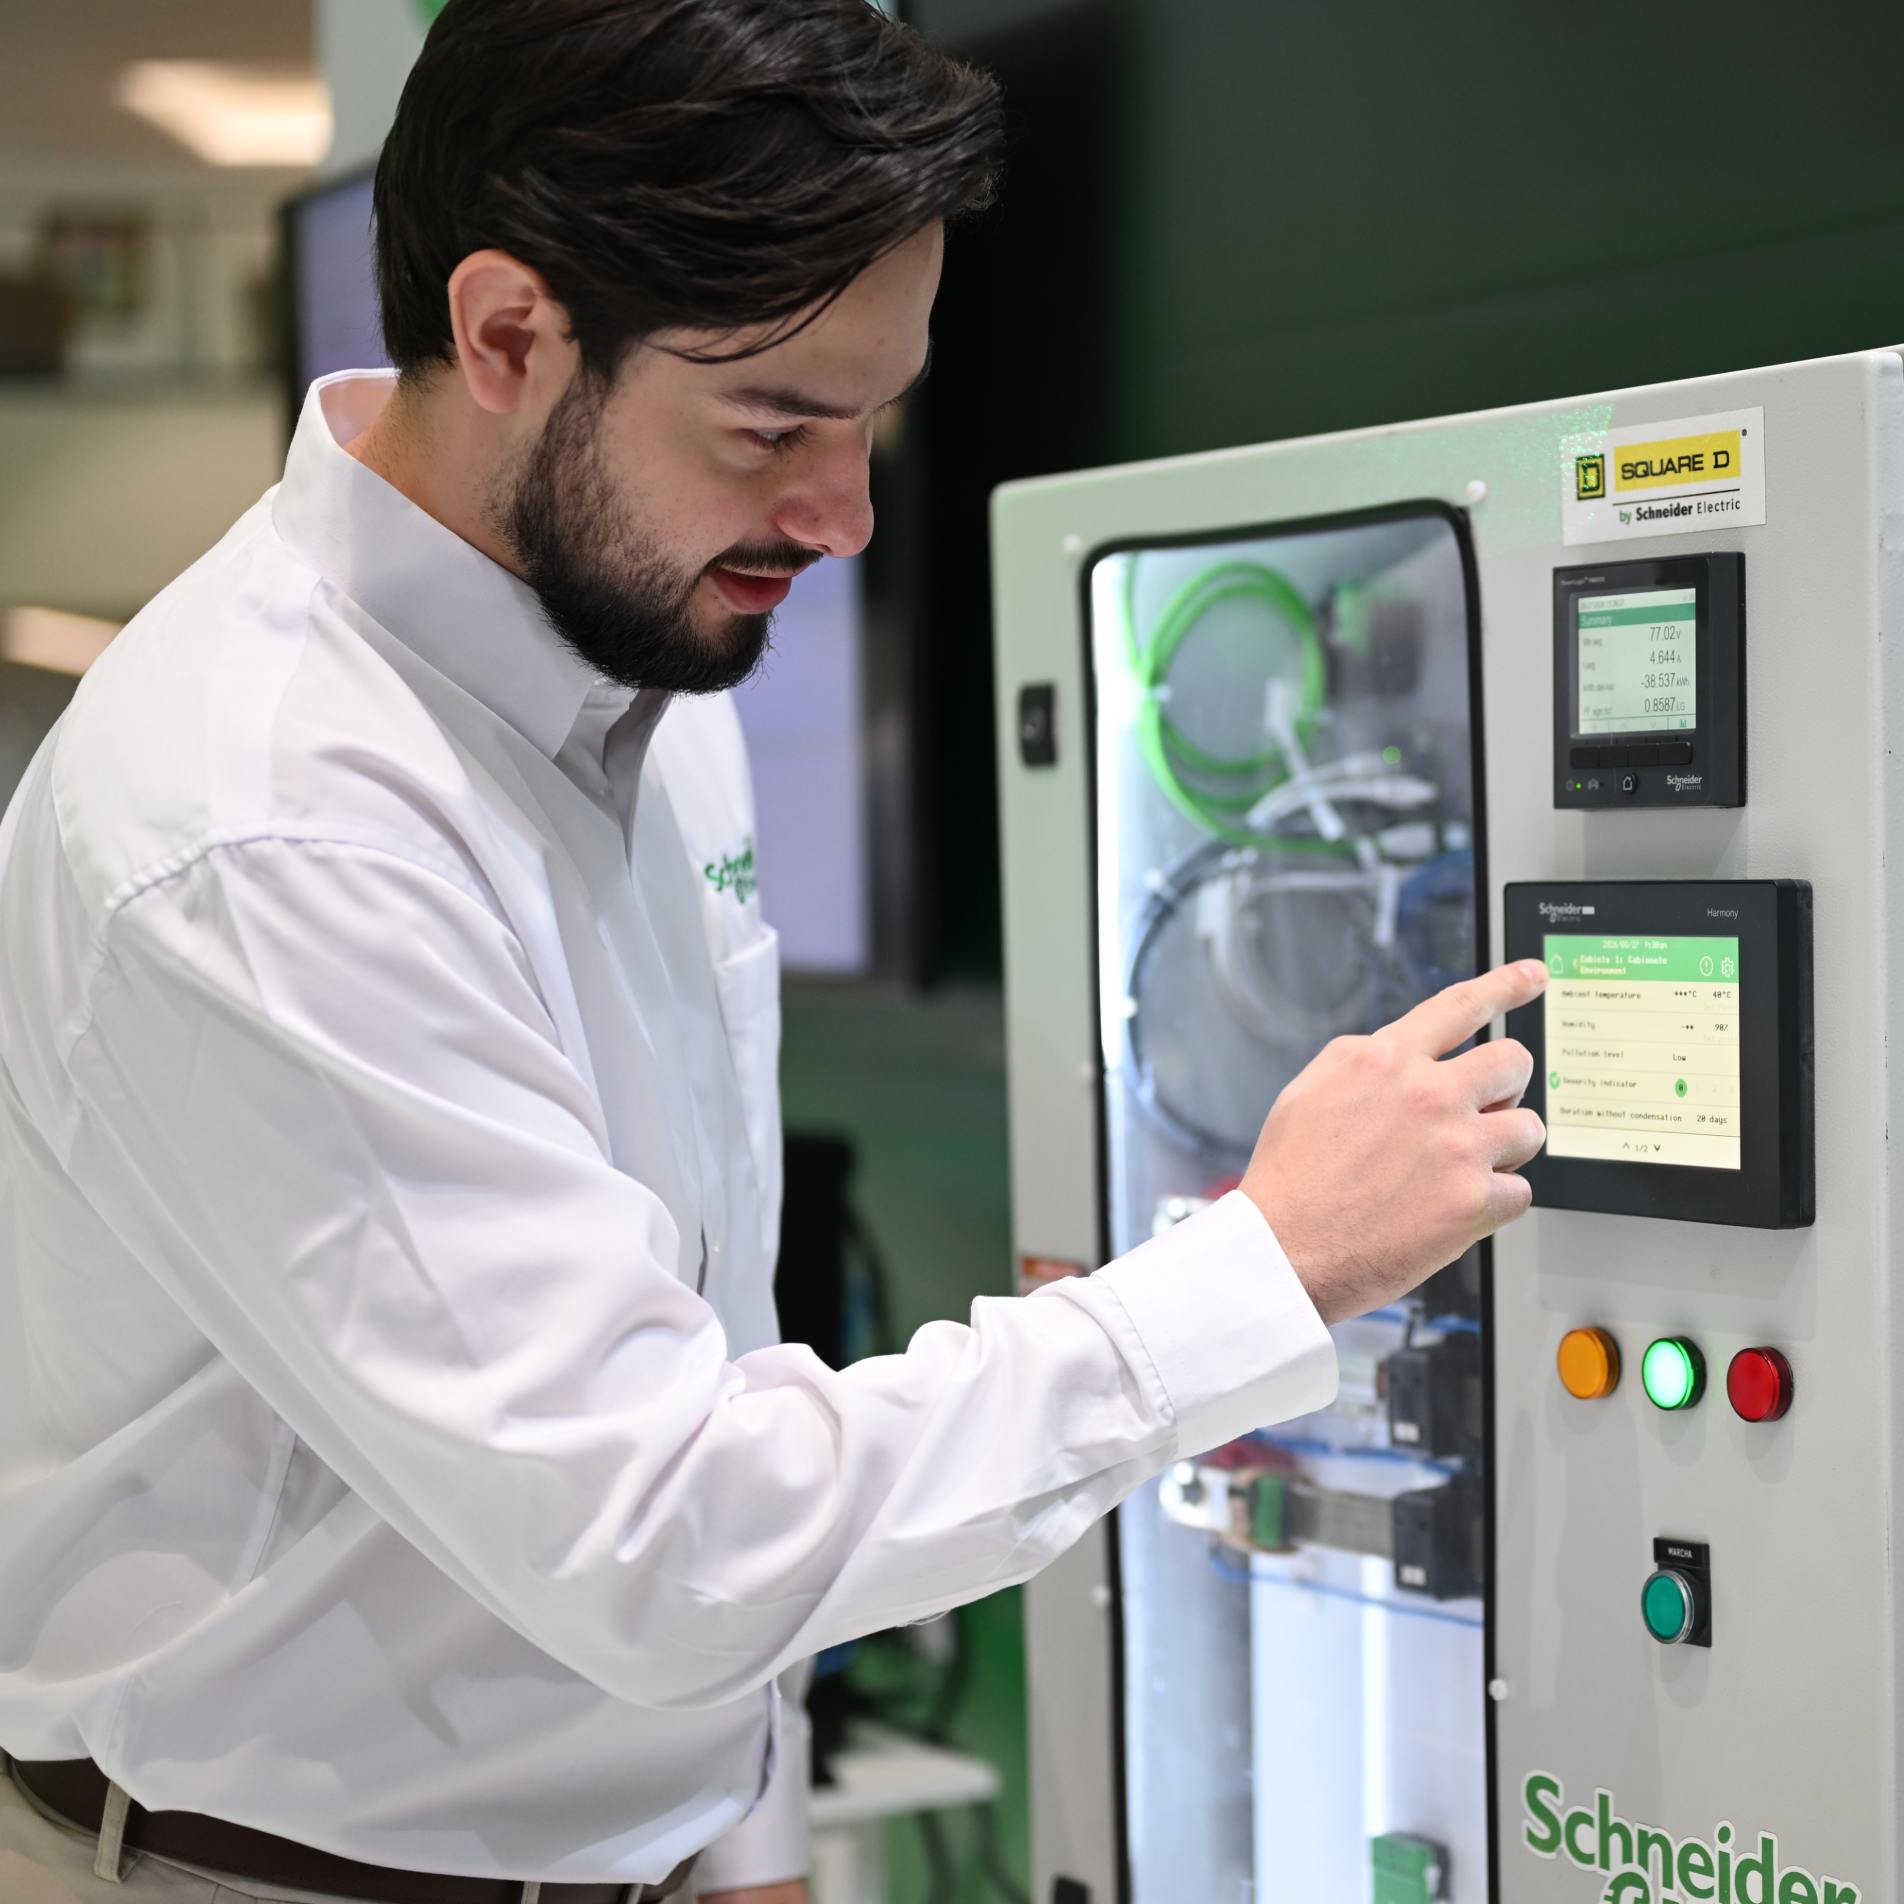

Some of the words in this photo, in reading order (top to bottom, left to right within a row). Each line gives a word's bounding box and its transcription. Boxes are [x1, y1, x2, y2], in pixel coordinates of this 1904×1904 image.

[1621, 453, 1704, 480] SQUARE
[1713, 450, 1730, 469] D
[1619, 511, 1633, 525] by
[1636, 502, 1693, 521] Schneider
[1697, 498, 1741, 514] Electric
[1666, 775, 1702, 785] Schneider
[1538, 902, 1582, 915] Schneider
[1707, 907, 1739, 920] Harmony
[1672, 1054, 1687, 1062] Low
[1630, 1112, 1683, 1122] condensation
[1709, 1116, 1728, 1126] days
[1668, 1547, 1693, 1559] MARCHA
[1525, 1774, 1858, 1904] Schneider
